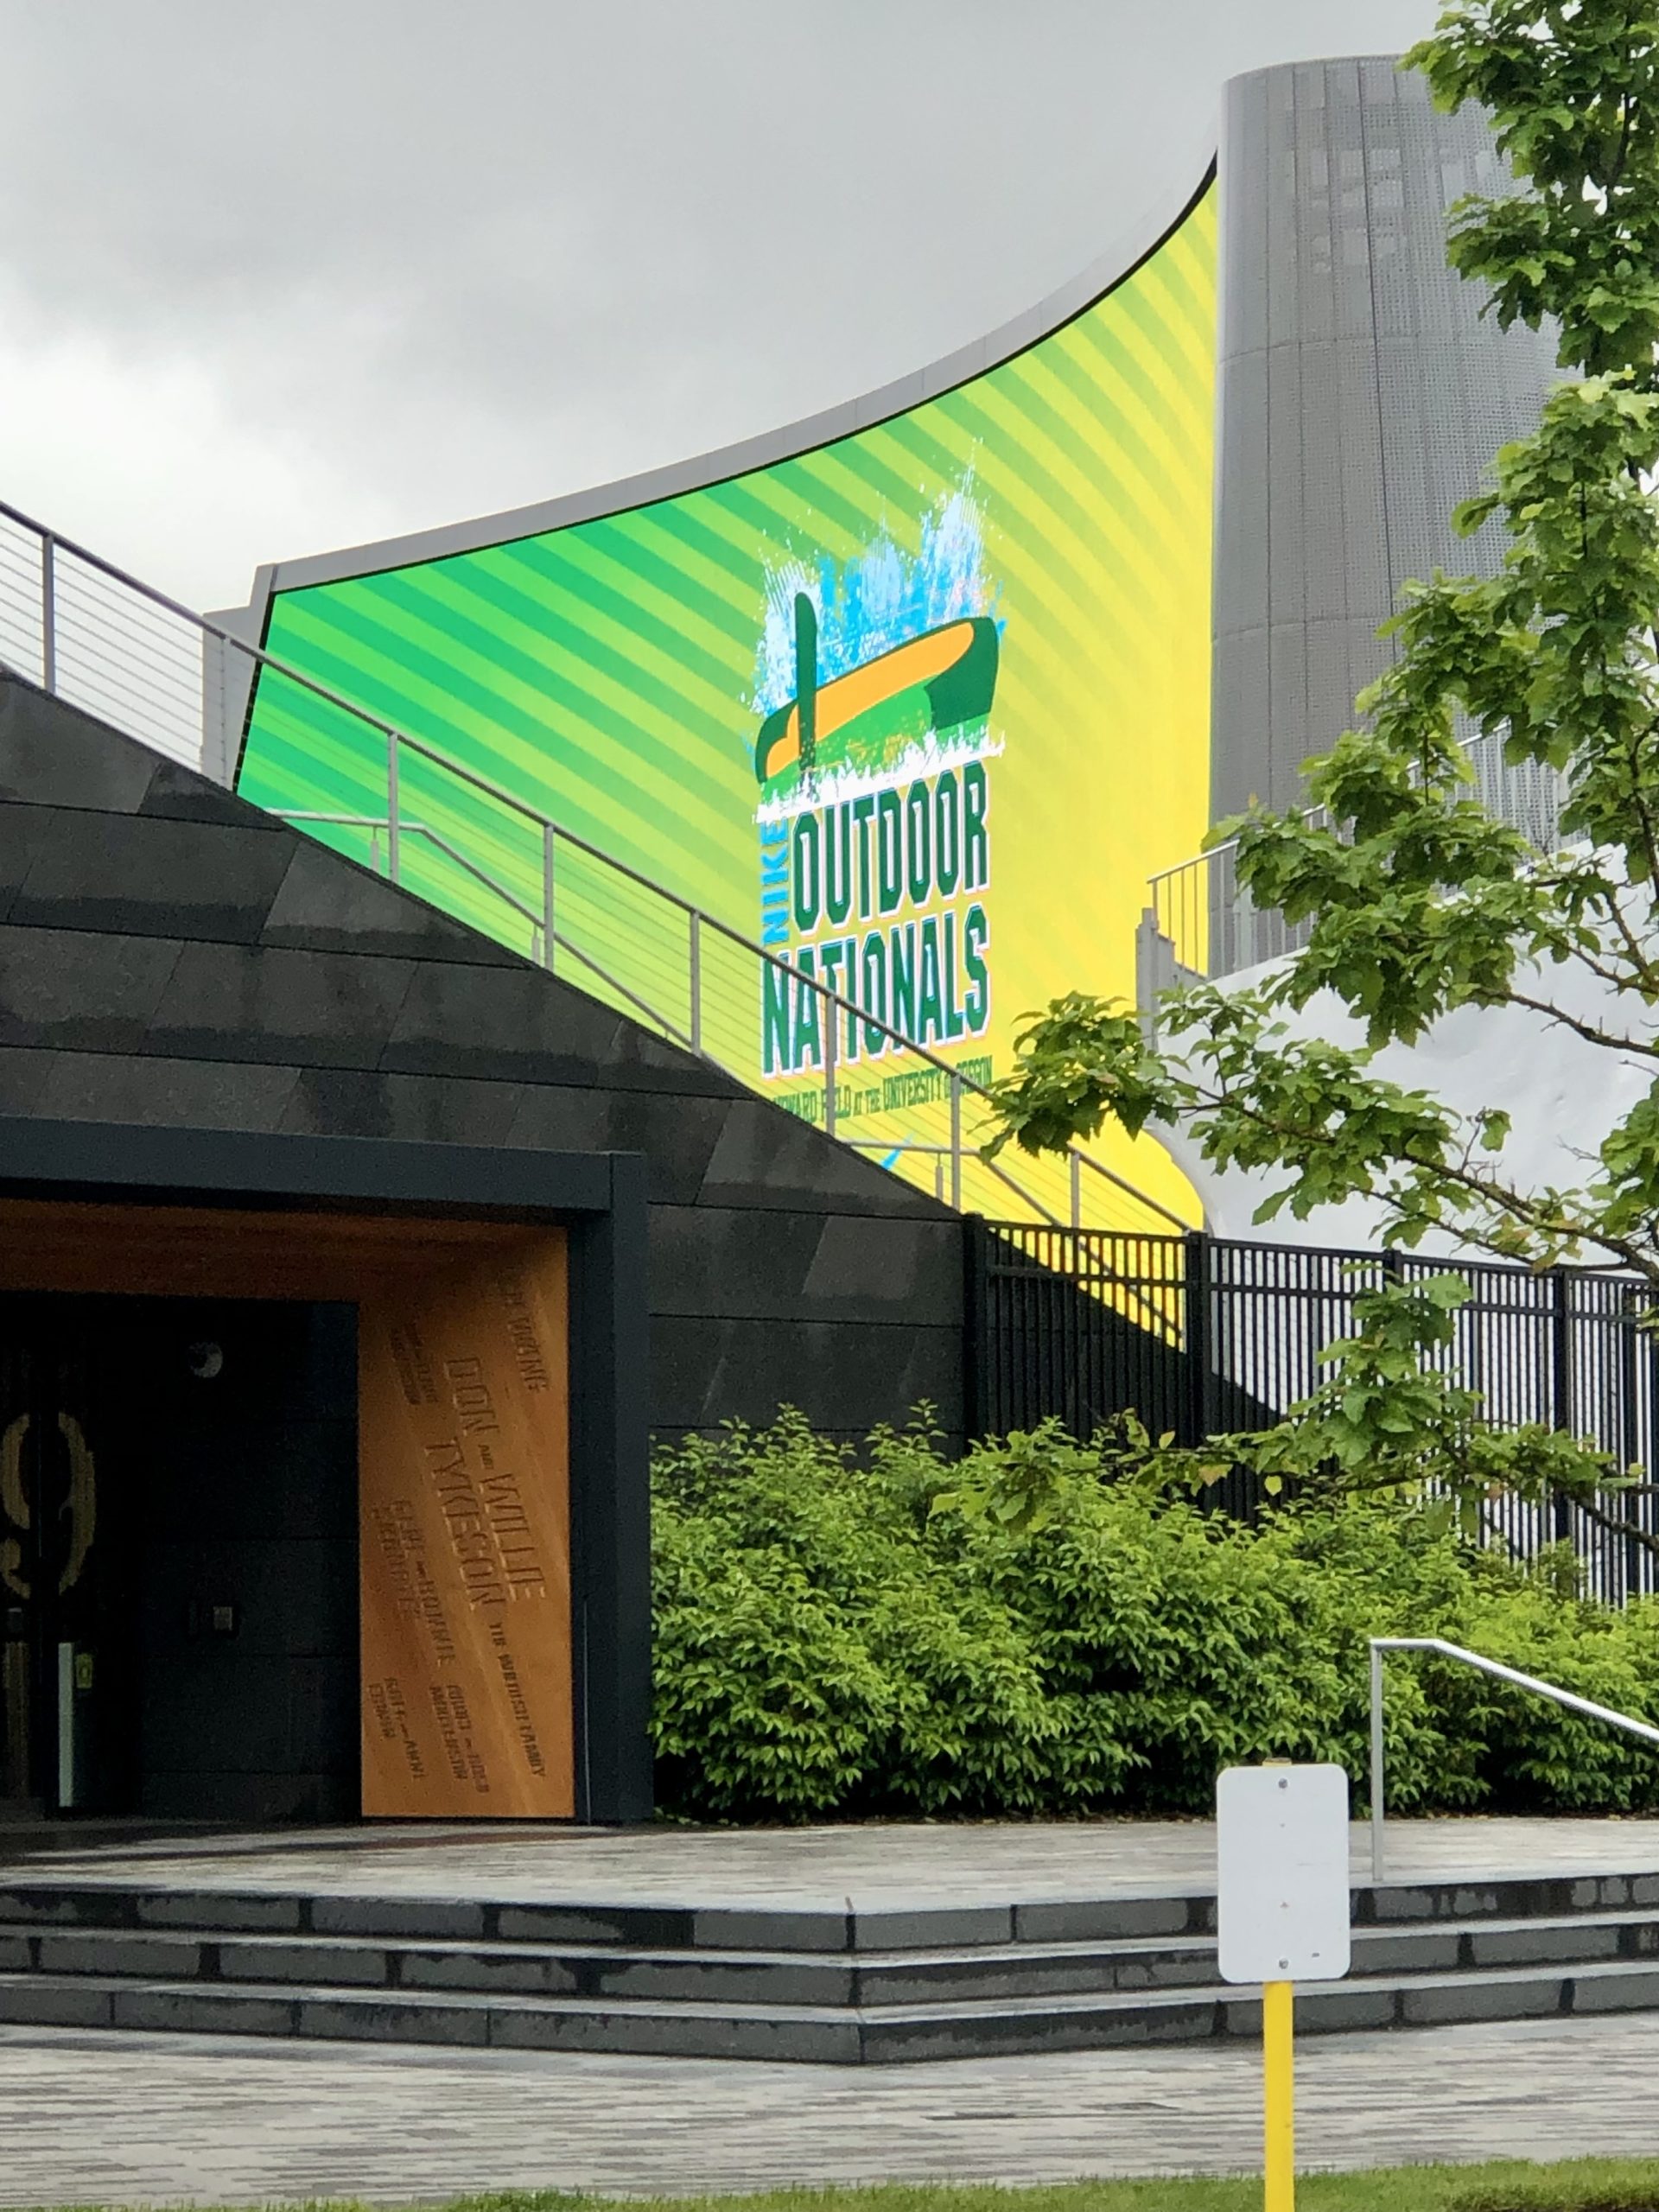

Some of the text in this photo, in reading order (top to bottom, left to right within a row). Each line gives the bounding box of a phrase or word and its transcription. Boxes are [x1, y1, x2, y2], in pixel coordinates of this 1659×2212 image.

[760, 817, 789, 945] NIKE
[793, 759, 989, 936] OUTDOOR
[762, 902, 991, 1078] NATIONALS
[883, 1067, 942, 1112] UNIVERSITY
[423, 1436, 507, 1611] TYKESON
[443, 1357, 499, 1436] DON
[480, 1472, 546, 1603] WILLIE
